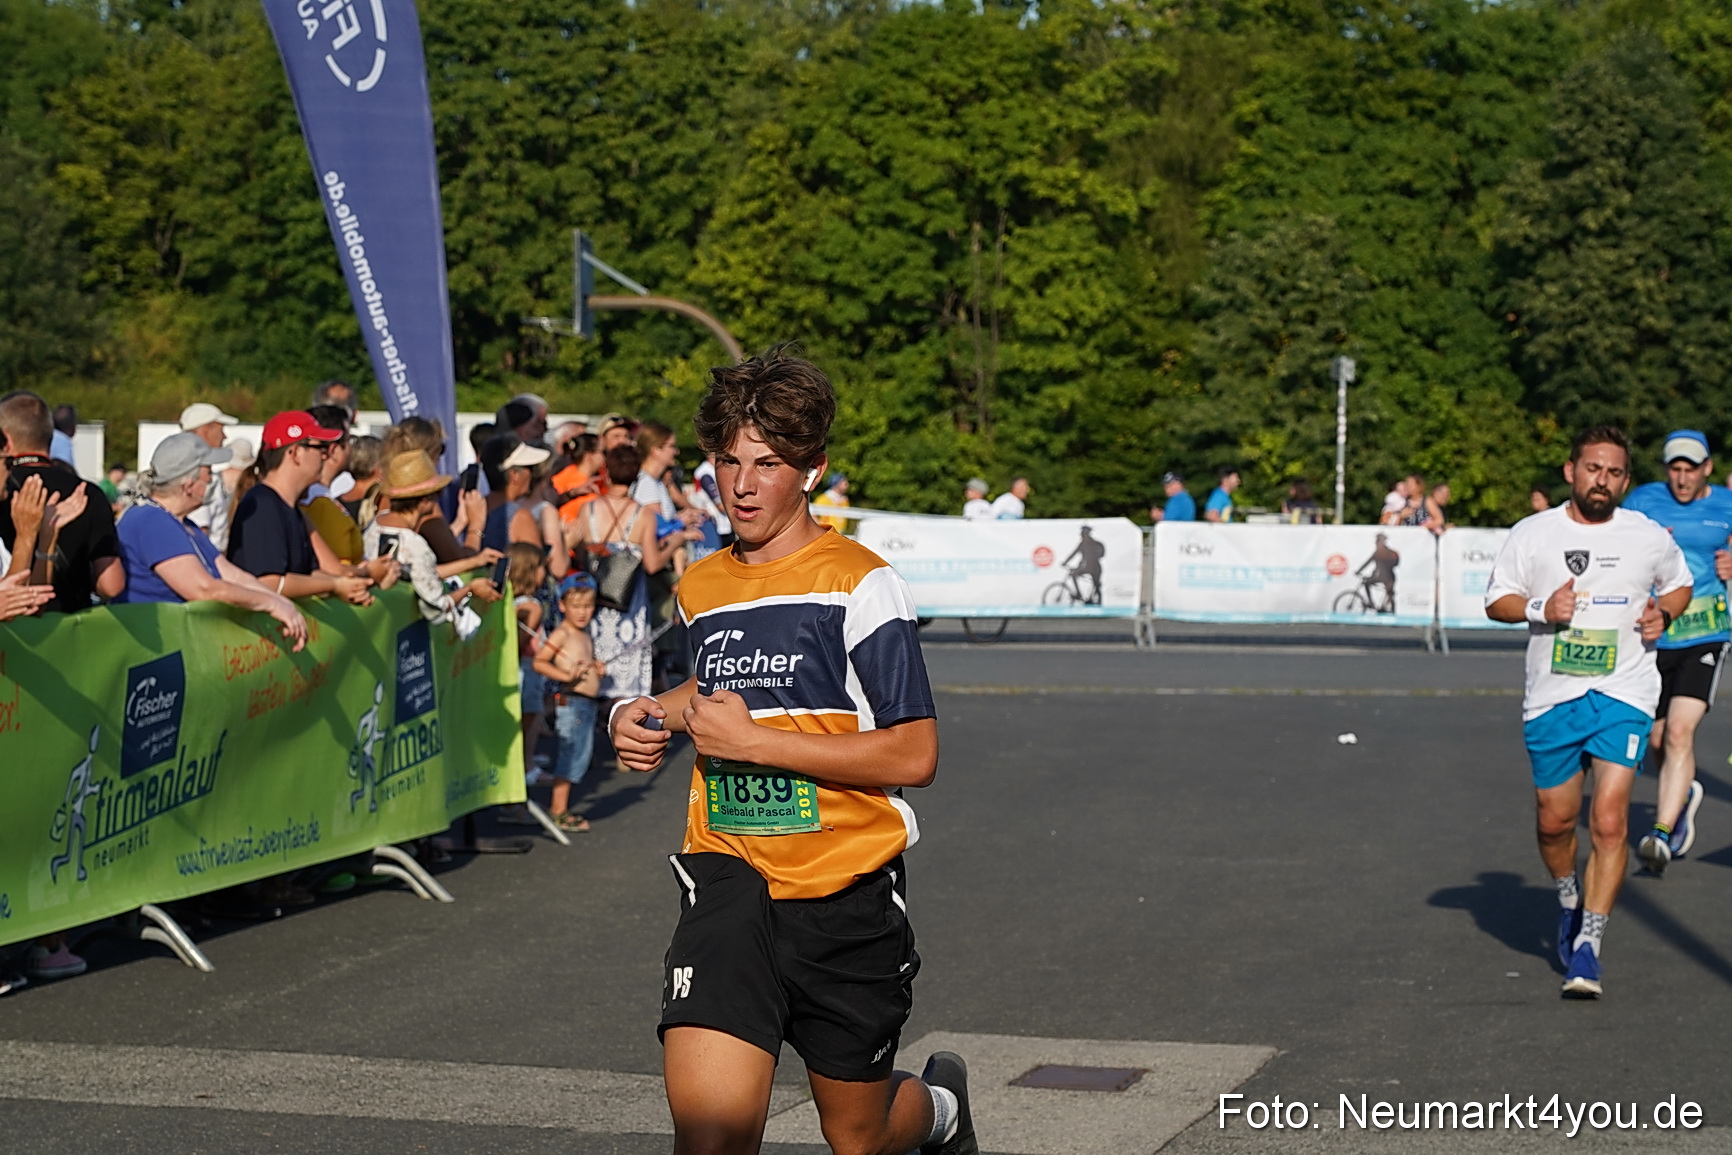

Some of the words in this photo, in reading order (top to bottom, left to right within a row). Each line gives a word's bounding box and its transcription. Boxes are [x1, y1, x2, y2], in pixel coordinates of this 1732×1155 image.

[705, 649, 803, 679] Fischer
[1564, 642, 1608, 661] 1227
[712, 676, 794, 692] AUTOMOBILE
[134, 690, 179, 720] Fischer
[94, 728, 229, 844] firmenlauf
[709, 779, 720, 813] RUN
[718, 772, 794, 804] 1839
[795, 776, 813, 819] 2022
[720, 805, 755, 817] Siebald
[757, 805, 796, 817] Pascal
[93, 824, 151, 870] neumarkt
[672, 966, 694, 1000] PS
